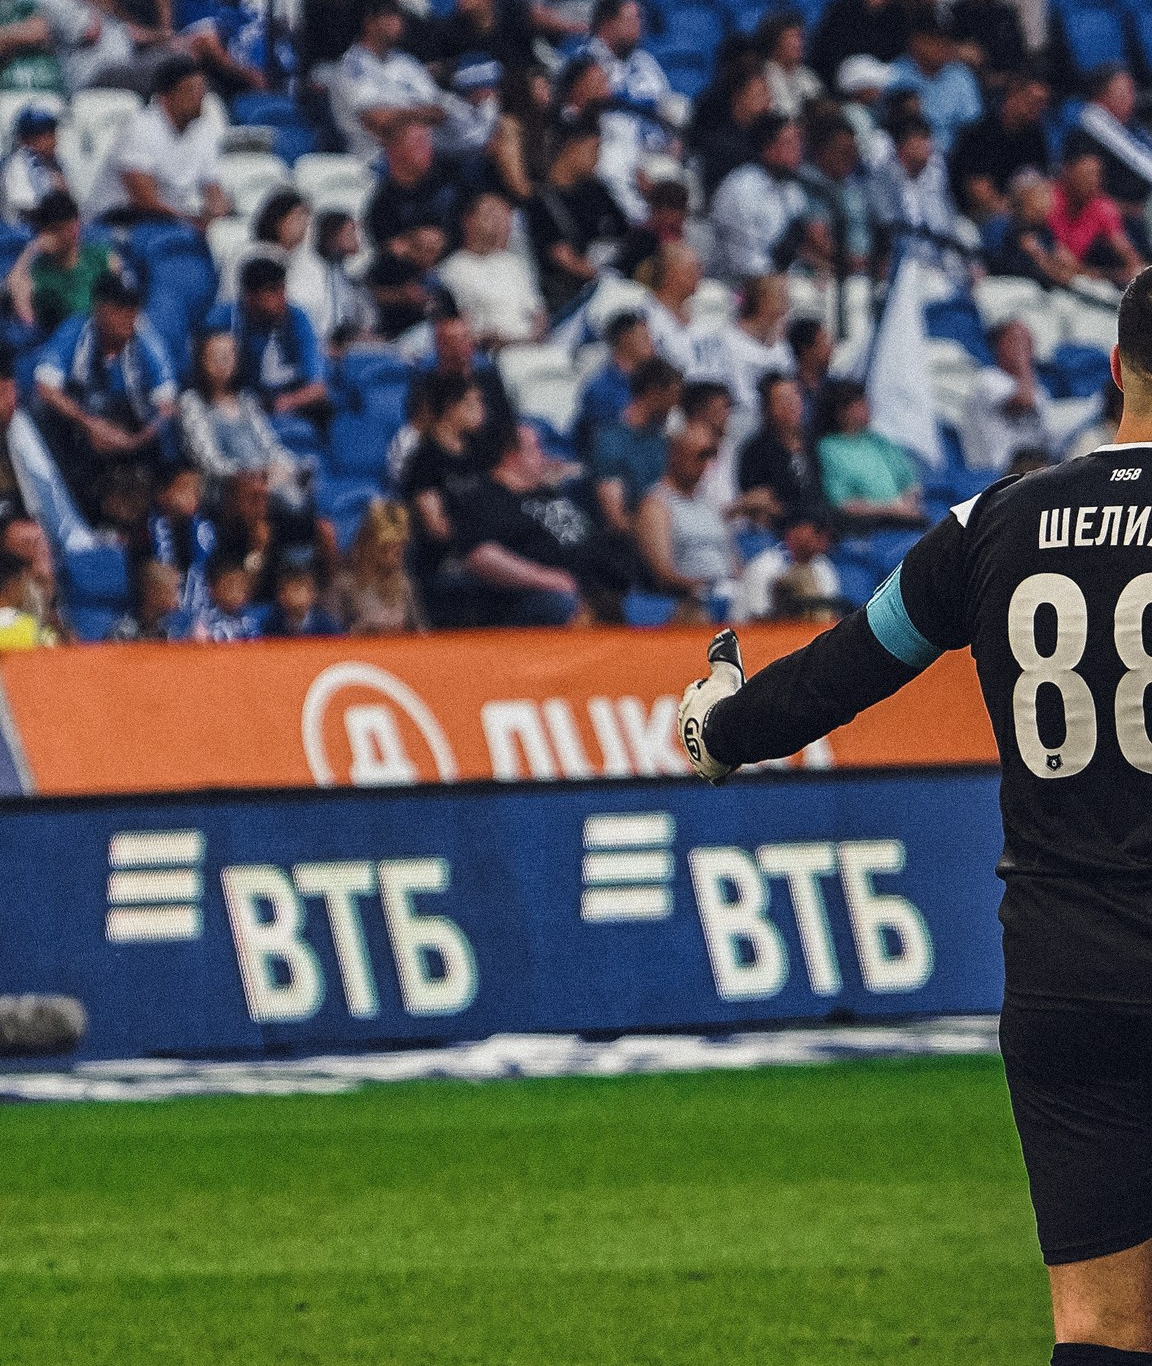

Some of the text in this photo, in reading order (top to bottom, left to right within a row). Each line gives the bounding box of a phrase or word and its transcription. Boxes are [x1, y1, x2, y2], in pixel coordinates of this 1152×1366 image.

[1109, 467, 1142, 482] 1958
[221, 857, 478, 1023] ВТБ
[688, 839, 933, 1001] ВТБ
